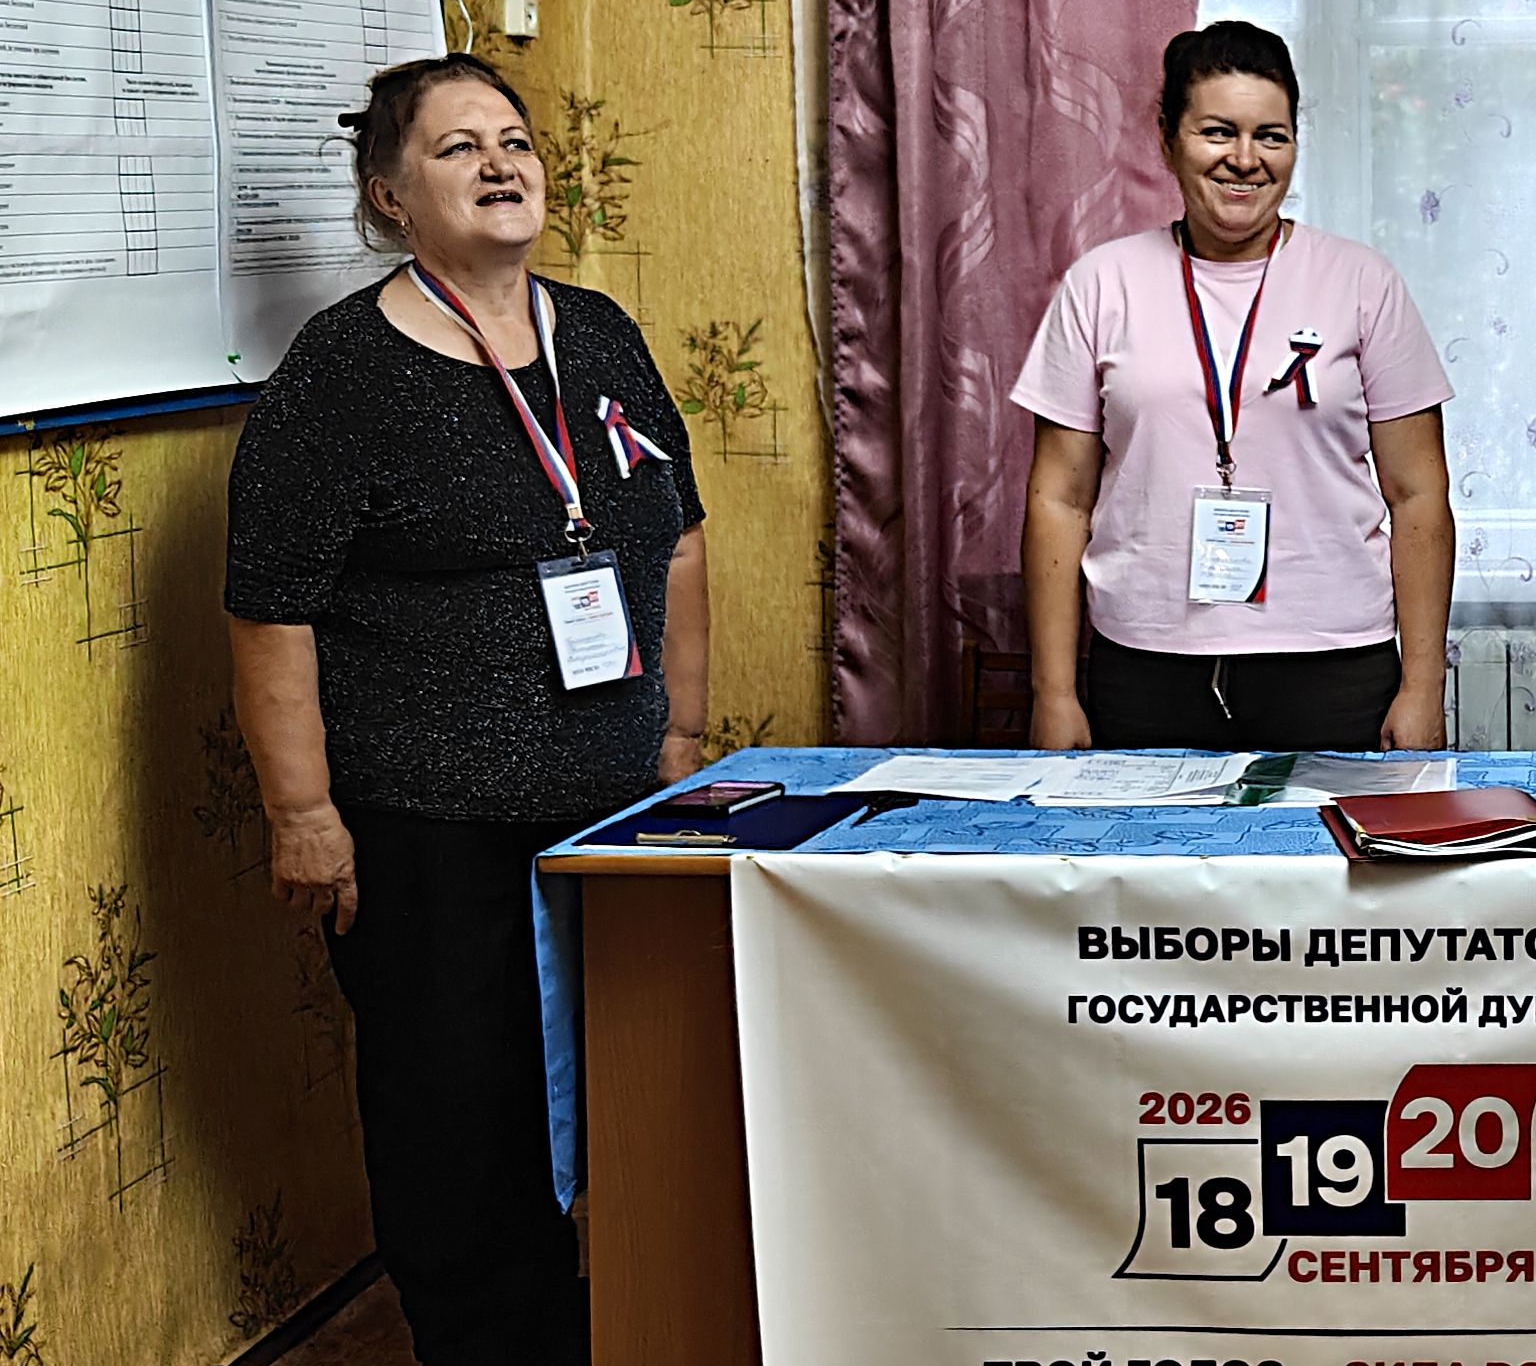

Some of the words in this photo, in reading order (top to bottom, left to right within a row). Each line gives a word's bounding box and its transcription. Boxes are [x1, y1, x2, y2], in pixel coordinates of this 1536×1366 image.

[1079, 928, 1292, 962] ВЫБОРЫ
[1069, 988, 1468, 1028] ГОСУДАРСТВЕННОЙ
[1140, 1093, 1252, 1125] 2026
[1402, 1098, 1520, 1169] 20
[1278, 1136, 1374, 1207] 19
[1157, 1178, 1255, 1250] 18
[1289, 1252, 1535, 1283] СЕНТЯБРЯ
